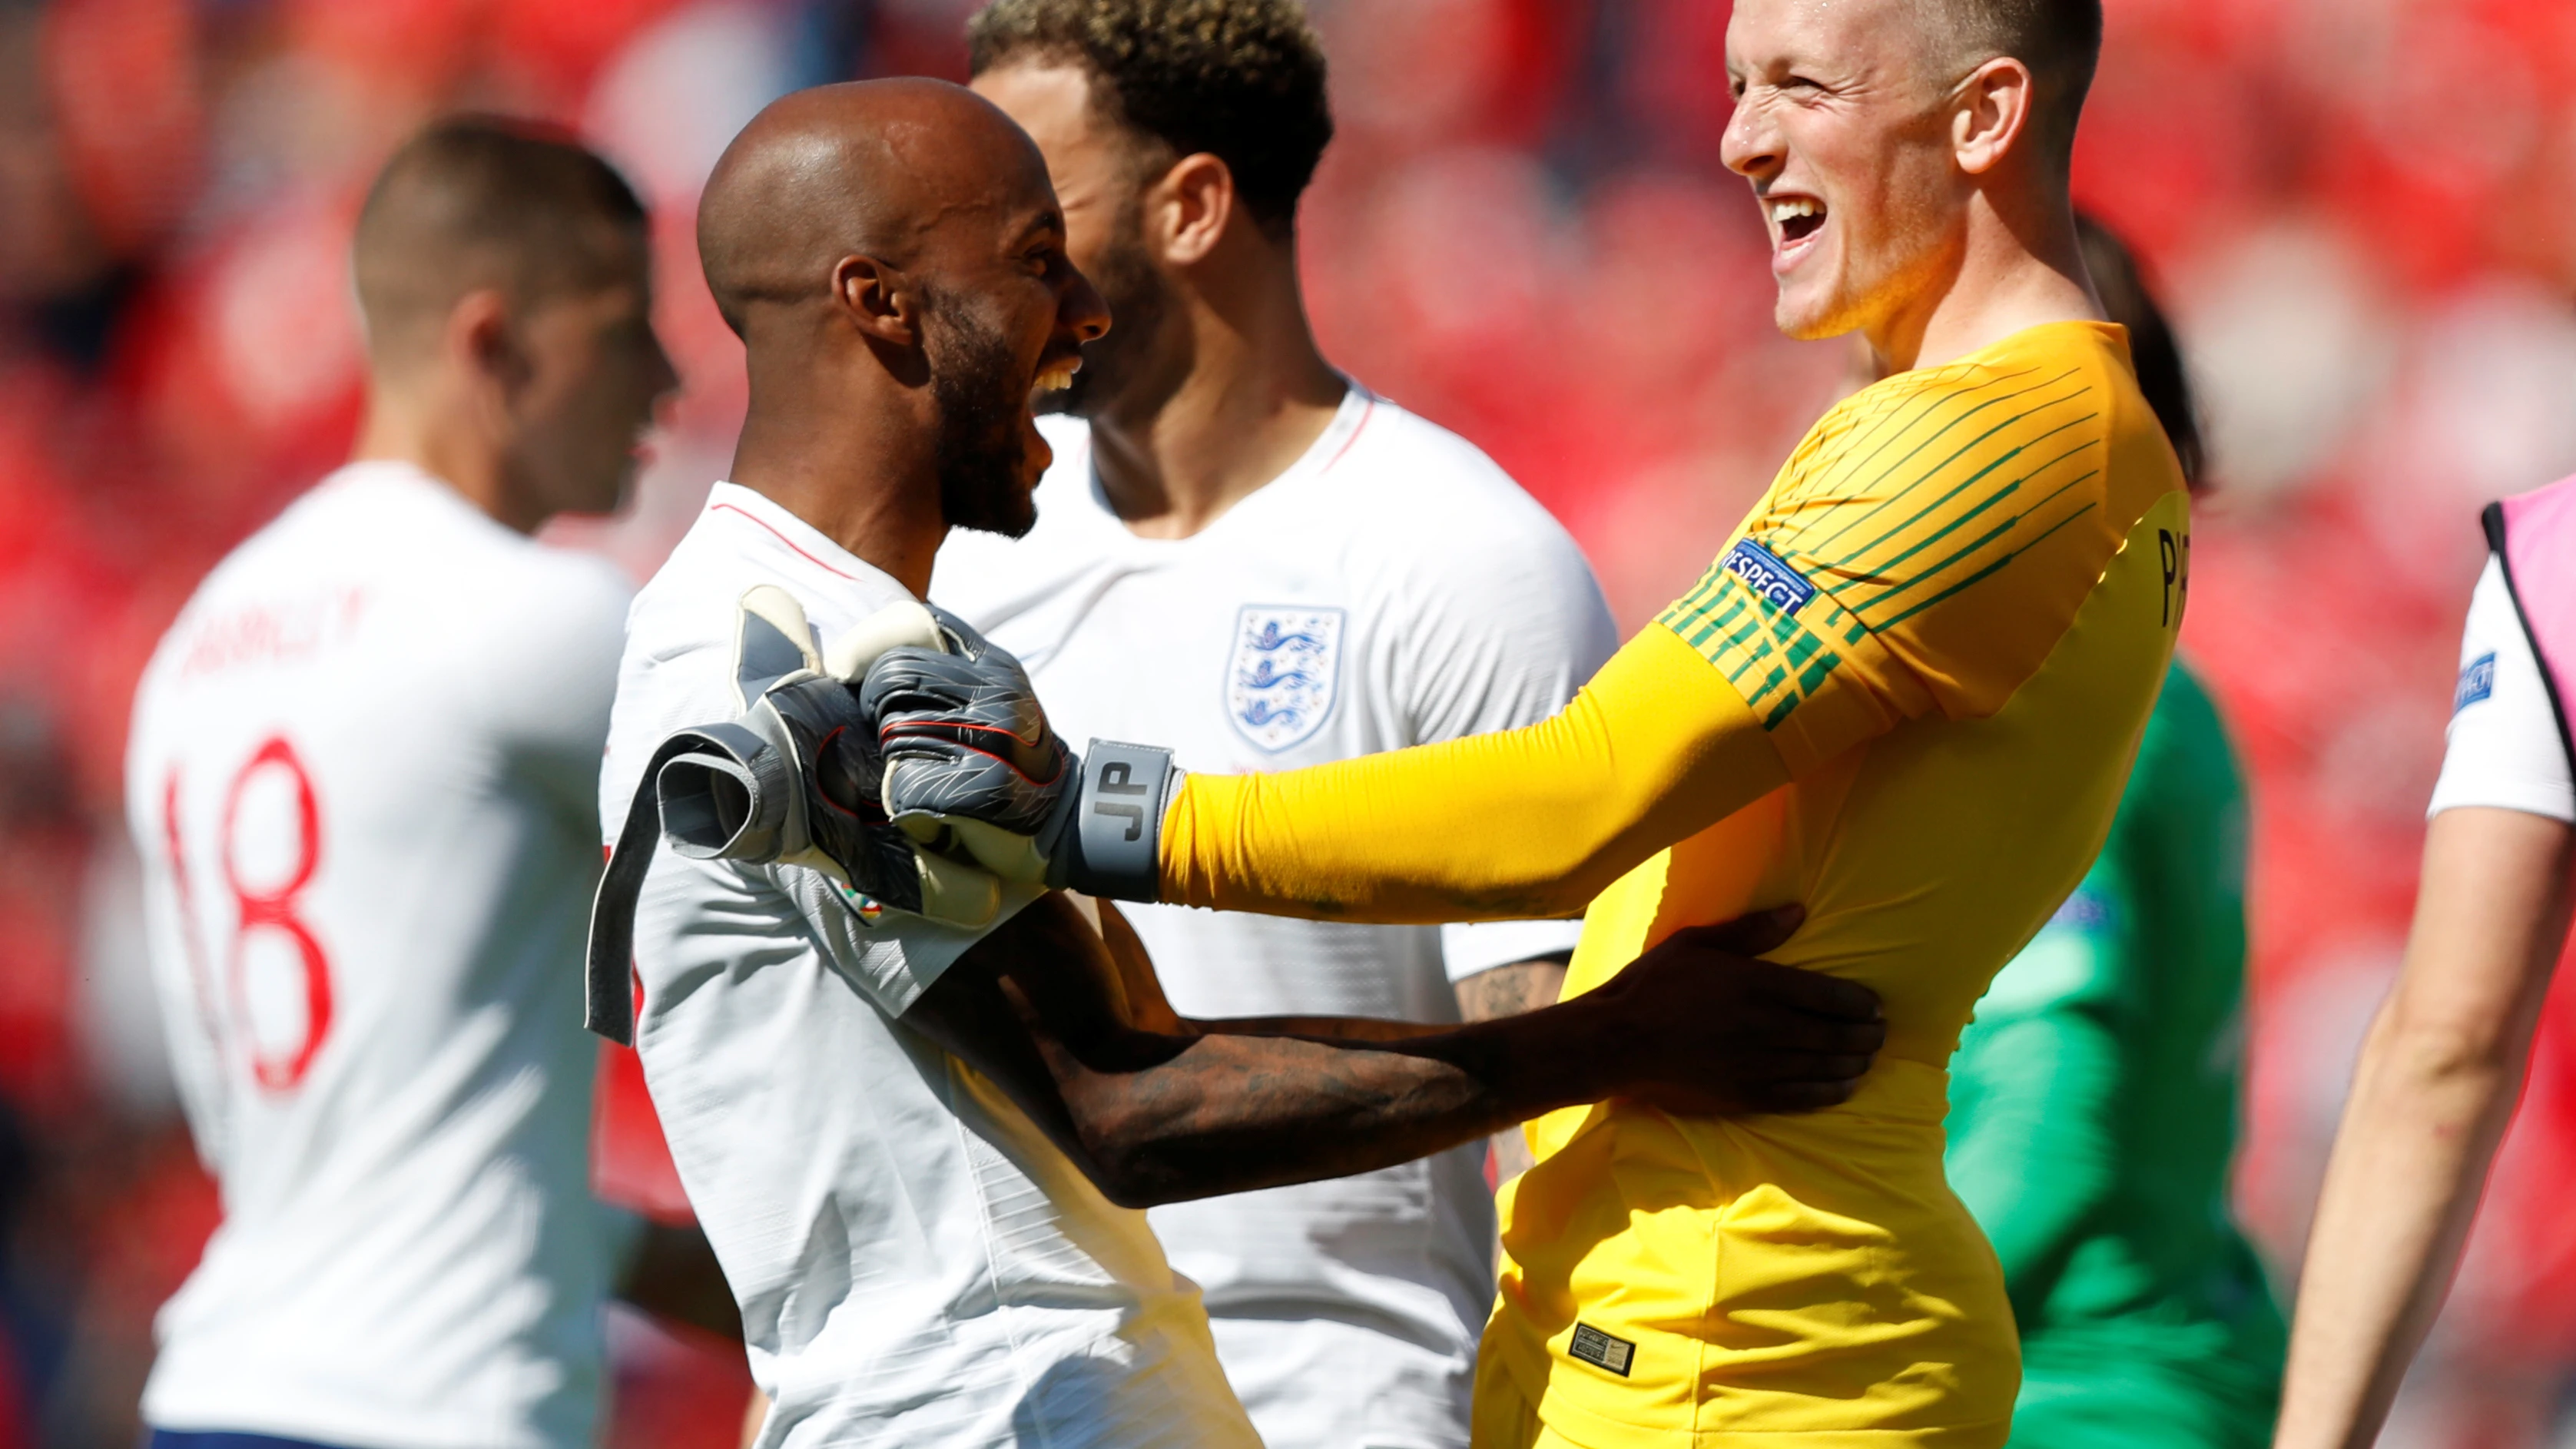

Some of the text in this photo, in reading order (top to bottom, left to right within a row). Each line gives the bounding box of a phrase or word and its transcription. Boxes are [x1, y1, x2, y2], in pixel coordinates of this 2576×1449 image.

[1720, 549, 1803, 612] RESPECT
[1093, 761, 1149, 842] JP
[164, 738, 333, 1094] 18
